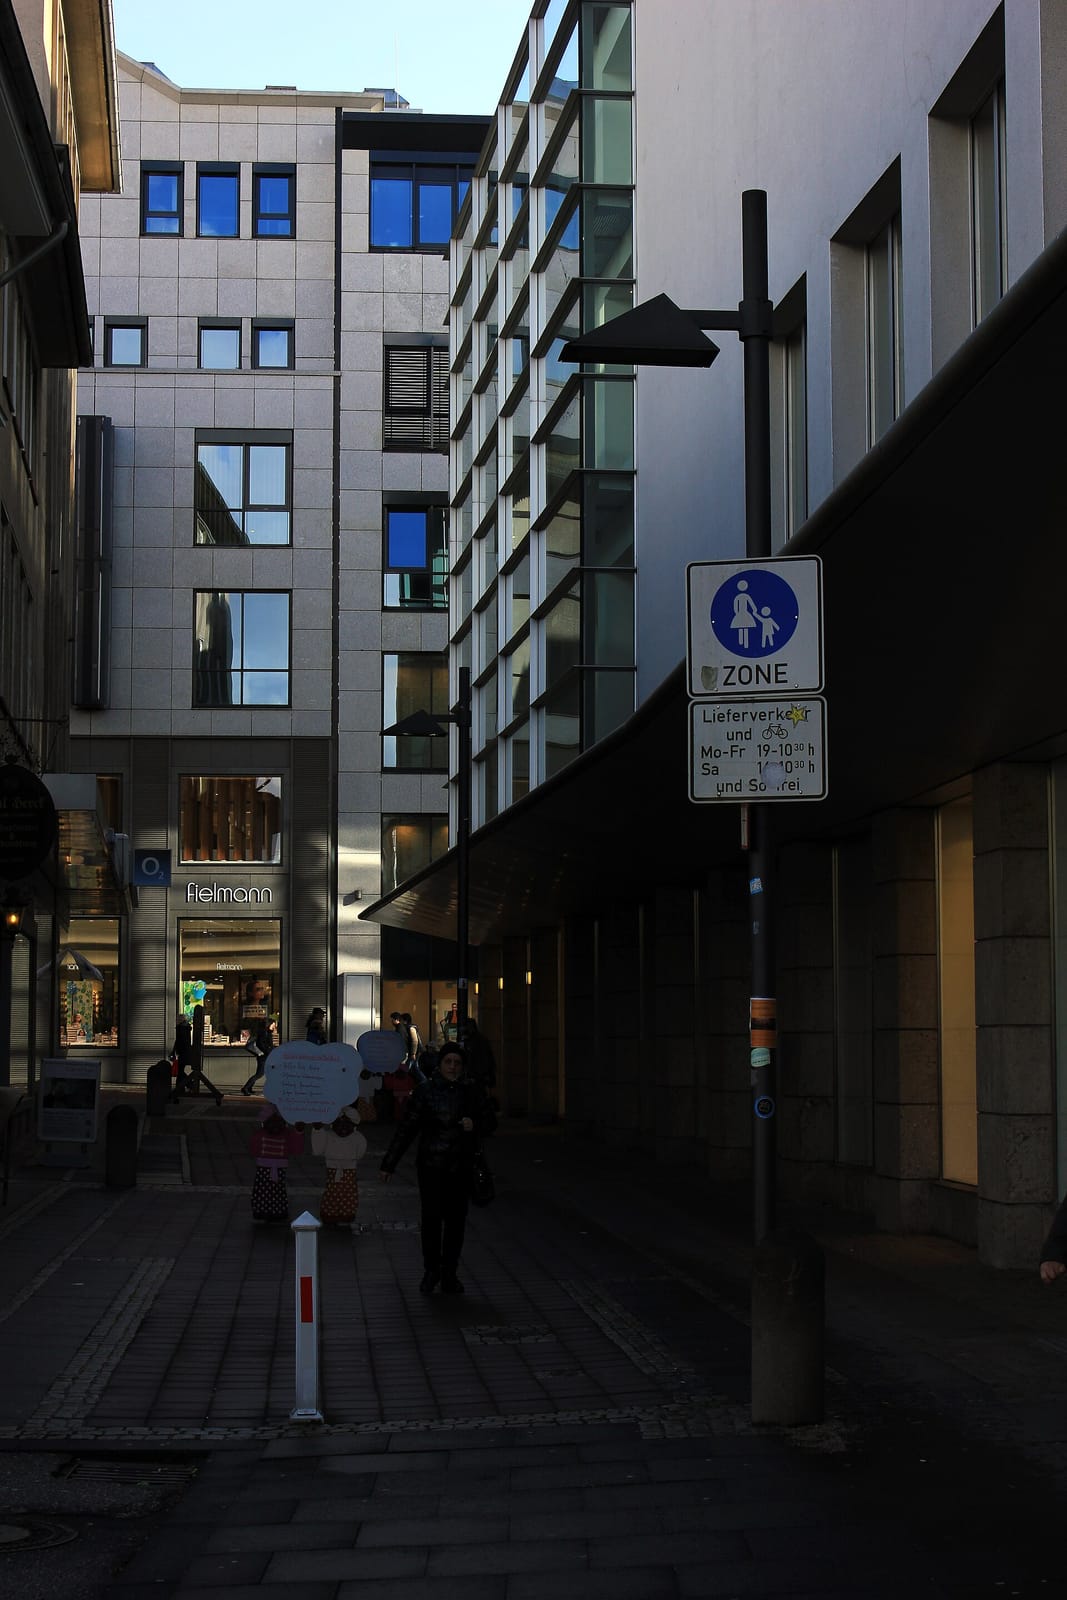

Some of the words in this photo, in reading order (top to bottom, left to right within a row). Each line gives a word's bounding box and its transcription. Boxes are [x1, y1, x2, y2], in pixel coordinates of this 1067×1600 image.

[723, 664, 789, 686] ZONE
[703, 707, 811, 723] Lieferverker
[726, 728, 752, 741] und
[701, 745, 746, 759] Mo-Fr
[808, 742, 815, 756] h
[701, 763, 719, 776] Sa
[808, 760, 815, 773] h
[716, 779, 742, 792] und
[748, 779, 766, 792] So
[776, 777, 800, 791] rei
[186, 882, 273, 903] fielmann
